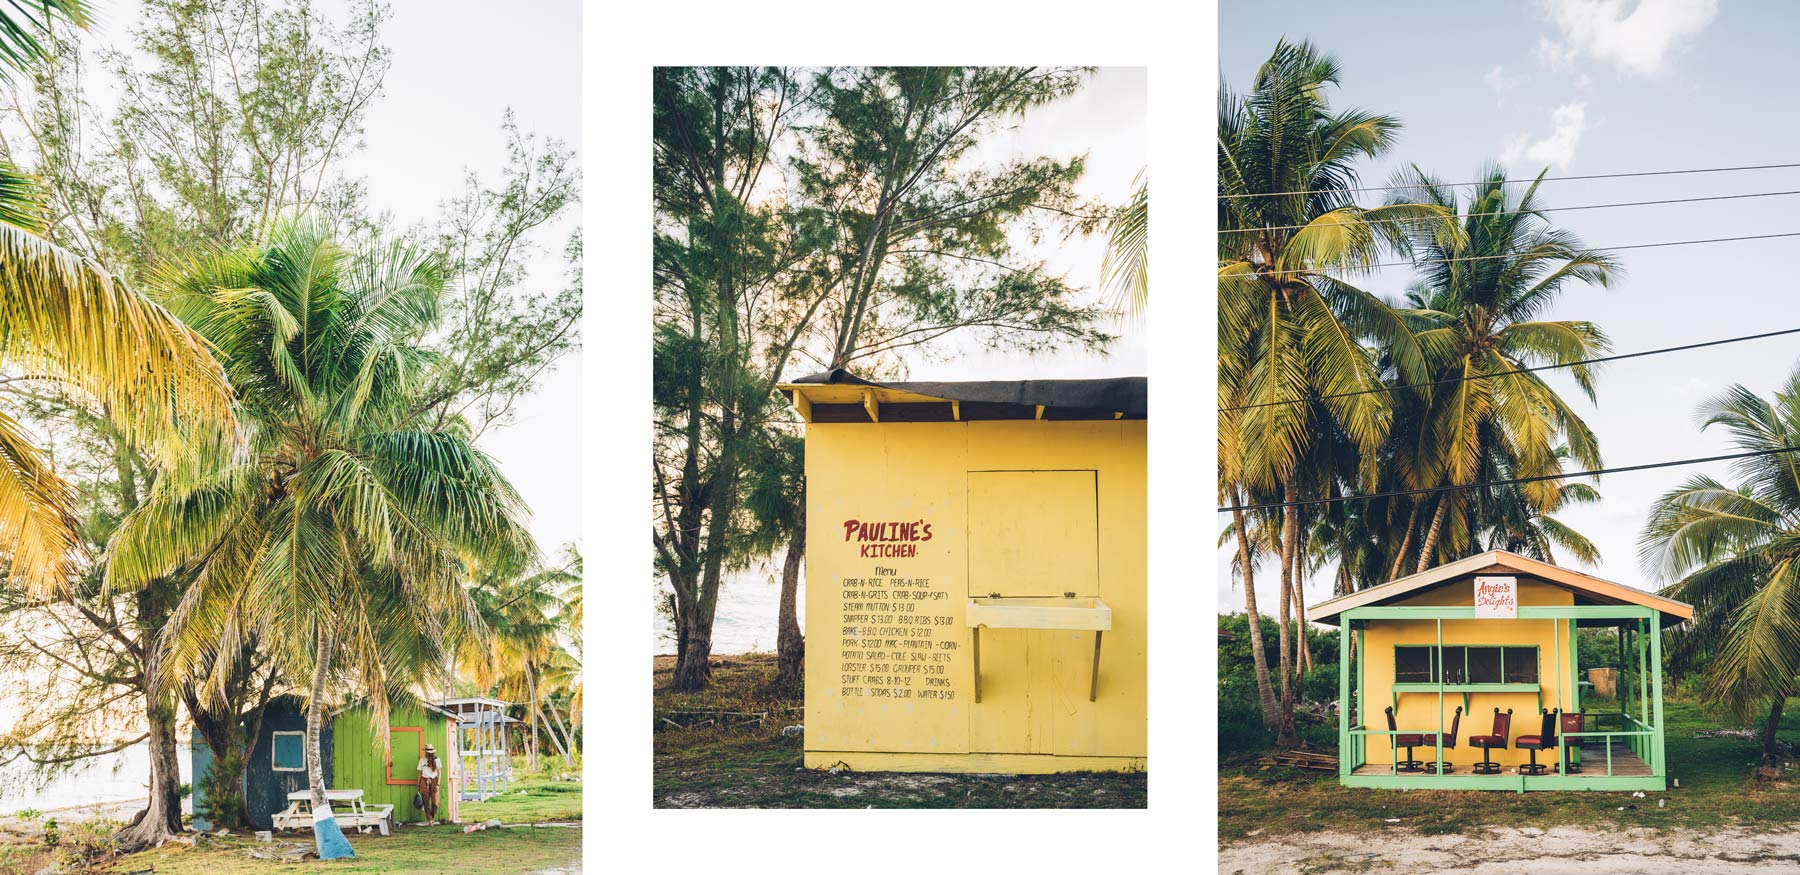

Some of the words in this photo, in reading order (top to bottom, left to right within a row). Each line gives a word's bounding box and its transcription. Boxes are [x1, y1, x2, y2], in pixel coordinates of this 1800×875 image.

[844, 519, 933, 542] PAULINE'S
[875, 566, 897, 576] Menu
[1477, 581, 1511, 598] Angie's
[843, 602, 864, 612] STEAM
[865, 602, 890, 612] MUTTON
[1477, 595, 1514, 611] Delights
[843, 614, 869, 624] SNAPPER
[914, 616, 931, 625] RIBS
[879, 627, 908, 637] CHICKEN
[842, 639, 858, 648] PORK
[841, 651, 864, 661] POTATO
[866, 651, 886, 661] SALAD
[891, 652, 907, 661] COLE
[892, 664, 921, 674] GROUPER
[841, 675, 861, 684] STUFF
[862, 675, 884, 685] CRABS
[925, 677, 951, 687] DRINKS
[841, 687, 863, 697] BOTTLE
[870, 687, 891, 698] SODAS
[917, 690, 938, 699] WATER
